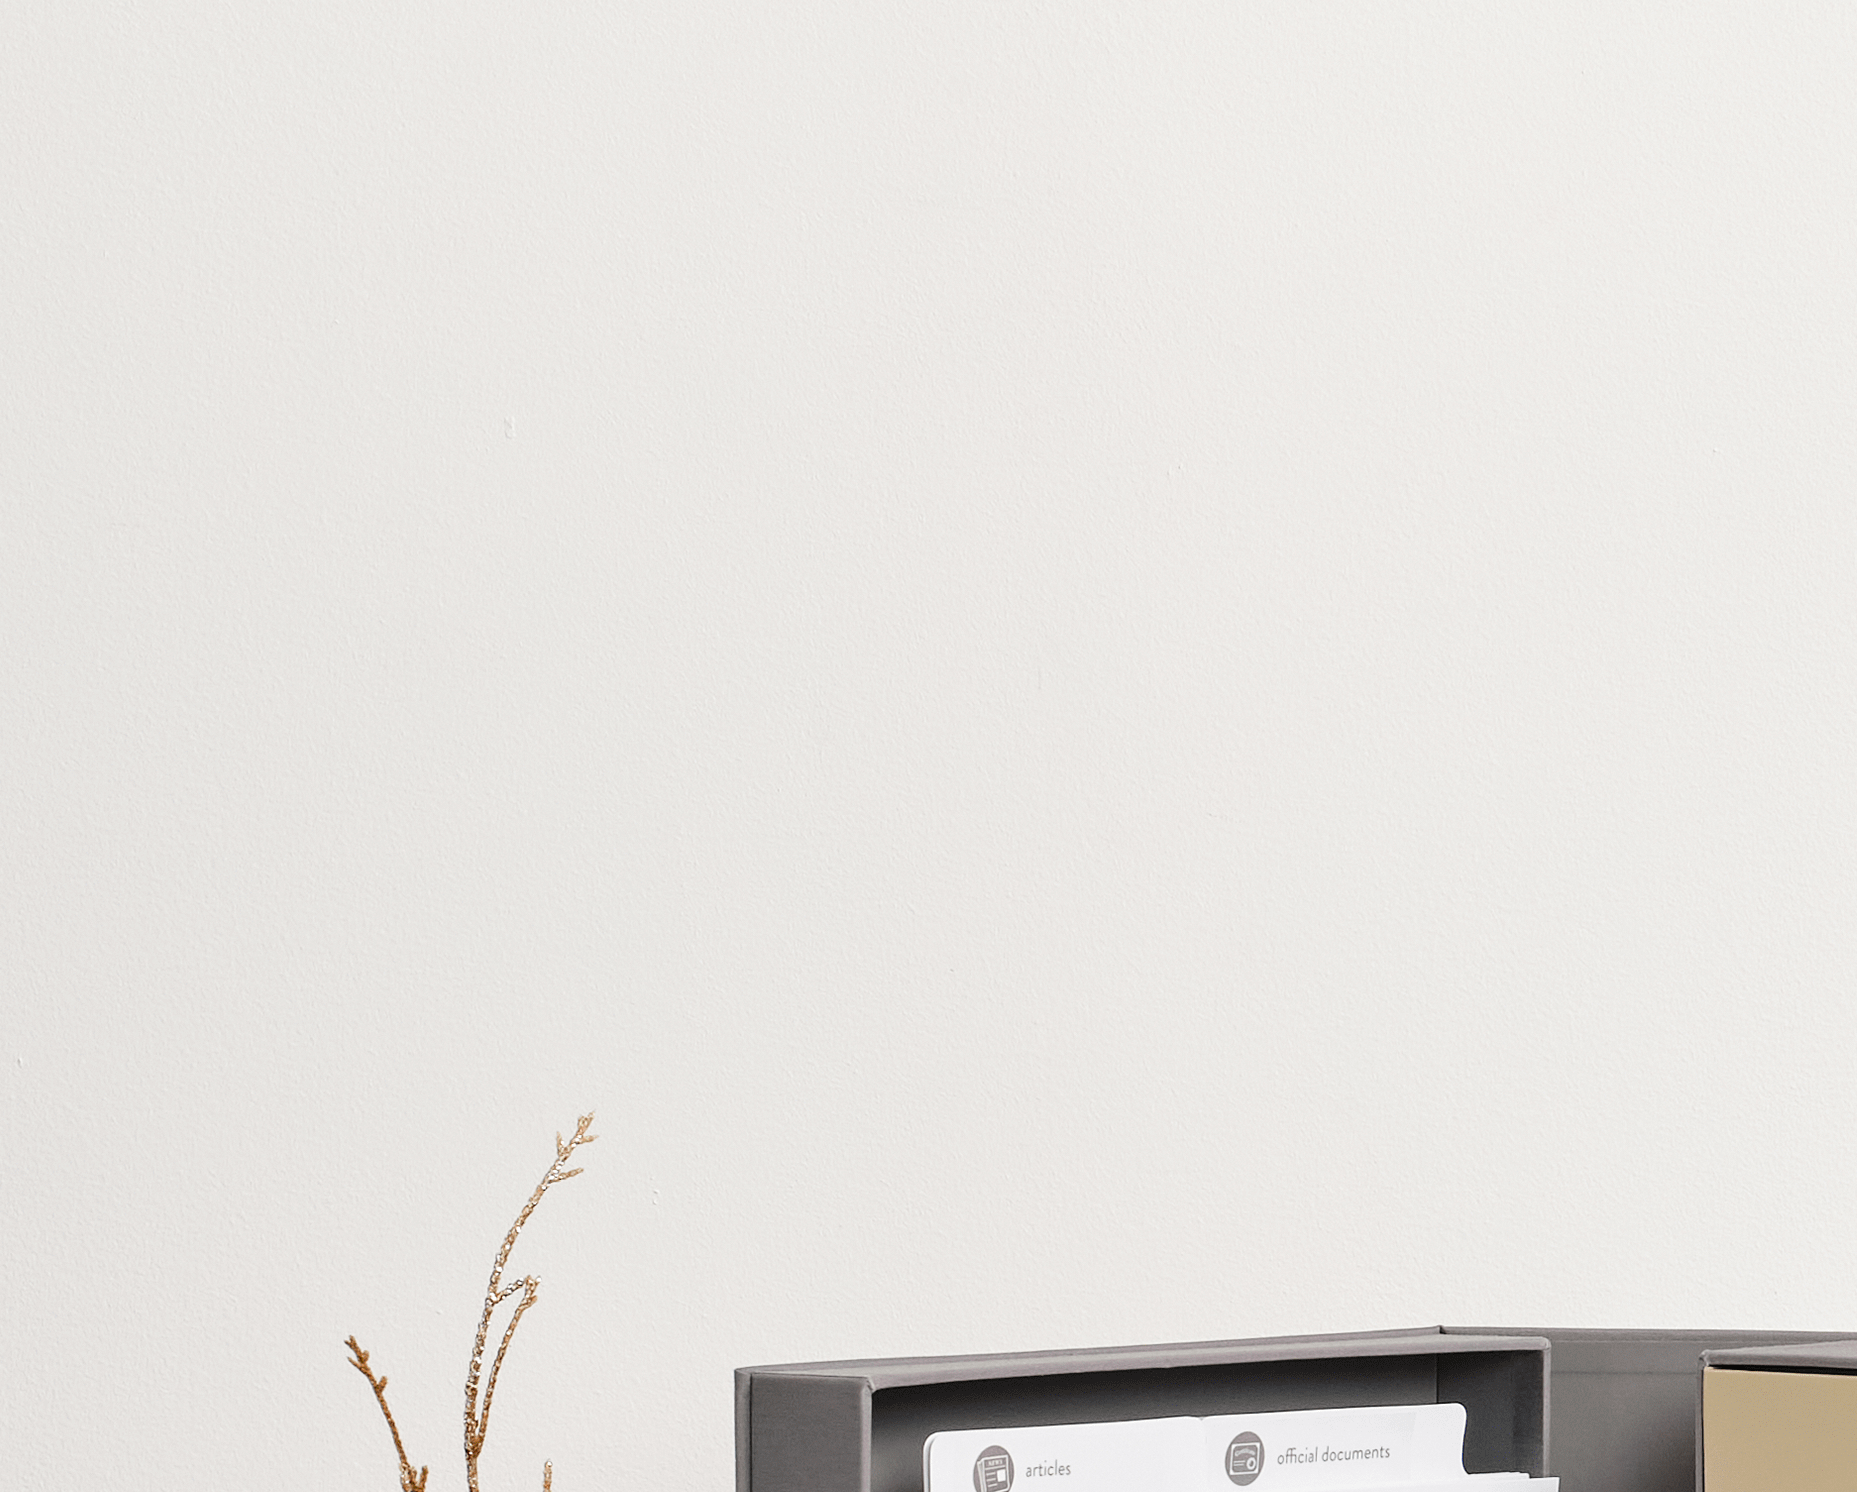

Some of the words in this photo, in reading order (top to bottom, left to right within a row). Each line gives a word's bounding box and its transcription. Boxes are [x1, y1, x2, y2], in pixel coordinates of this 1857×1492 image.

[1277, 1446, 1318, 1465] official
[1321, 1445, 1391, 1462] documents
[1025, 1459, 1071, 1478] articles
